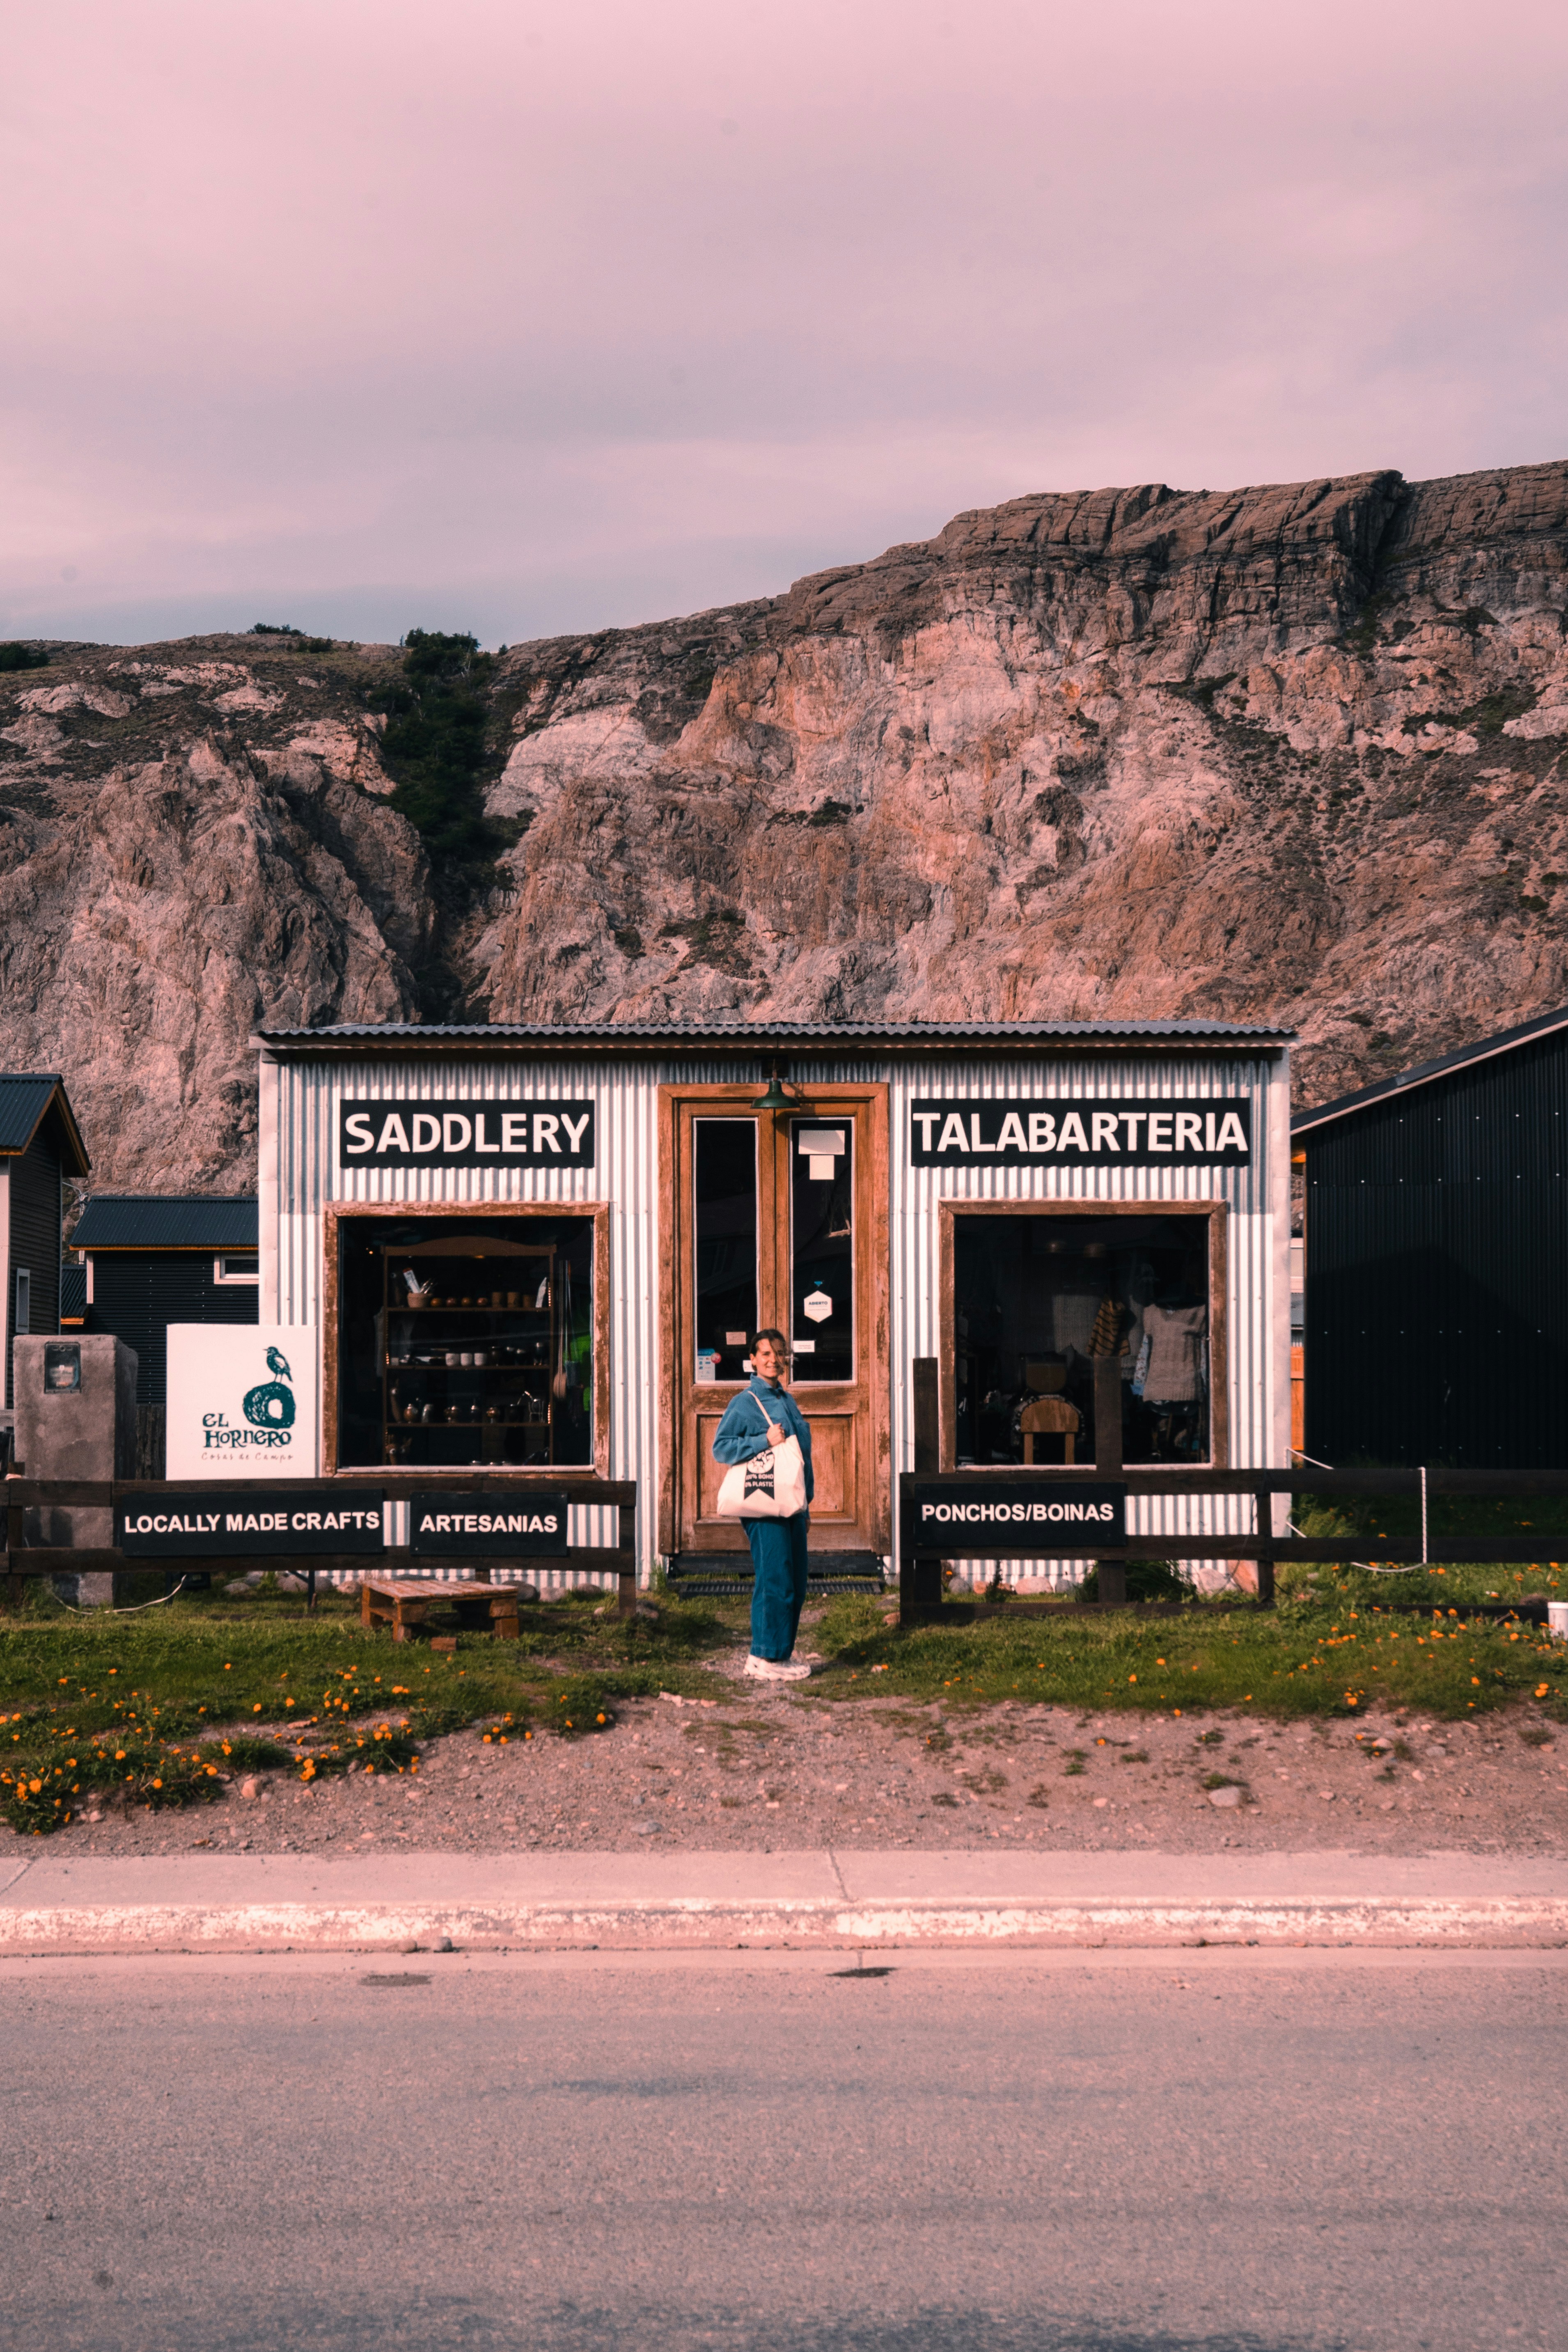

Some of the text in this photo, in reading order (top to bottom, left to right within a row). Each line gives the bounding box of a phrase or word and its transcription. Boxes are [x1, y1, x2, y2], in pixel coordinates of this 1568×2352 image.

[345, 1113, 589, 1153] SADDLERY
[912, 1112, 1248, 1152] TALABARTERIA
[201, 1452, 234, 1460] Cosas
[255, 1452, 293, 1463] Campo
[125, 1511, 380, 1533] LOCALLY MADE CRAFTS
[922, 1503, 1114, 1522] PONCHOS/BOINAS
[420, 1514, 557, 1533] ARTESANIAS
